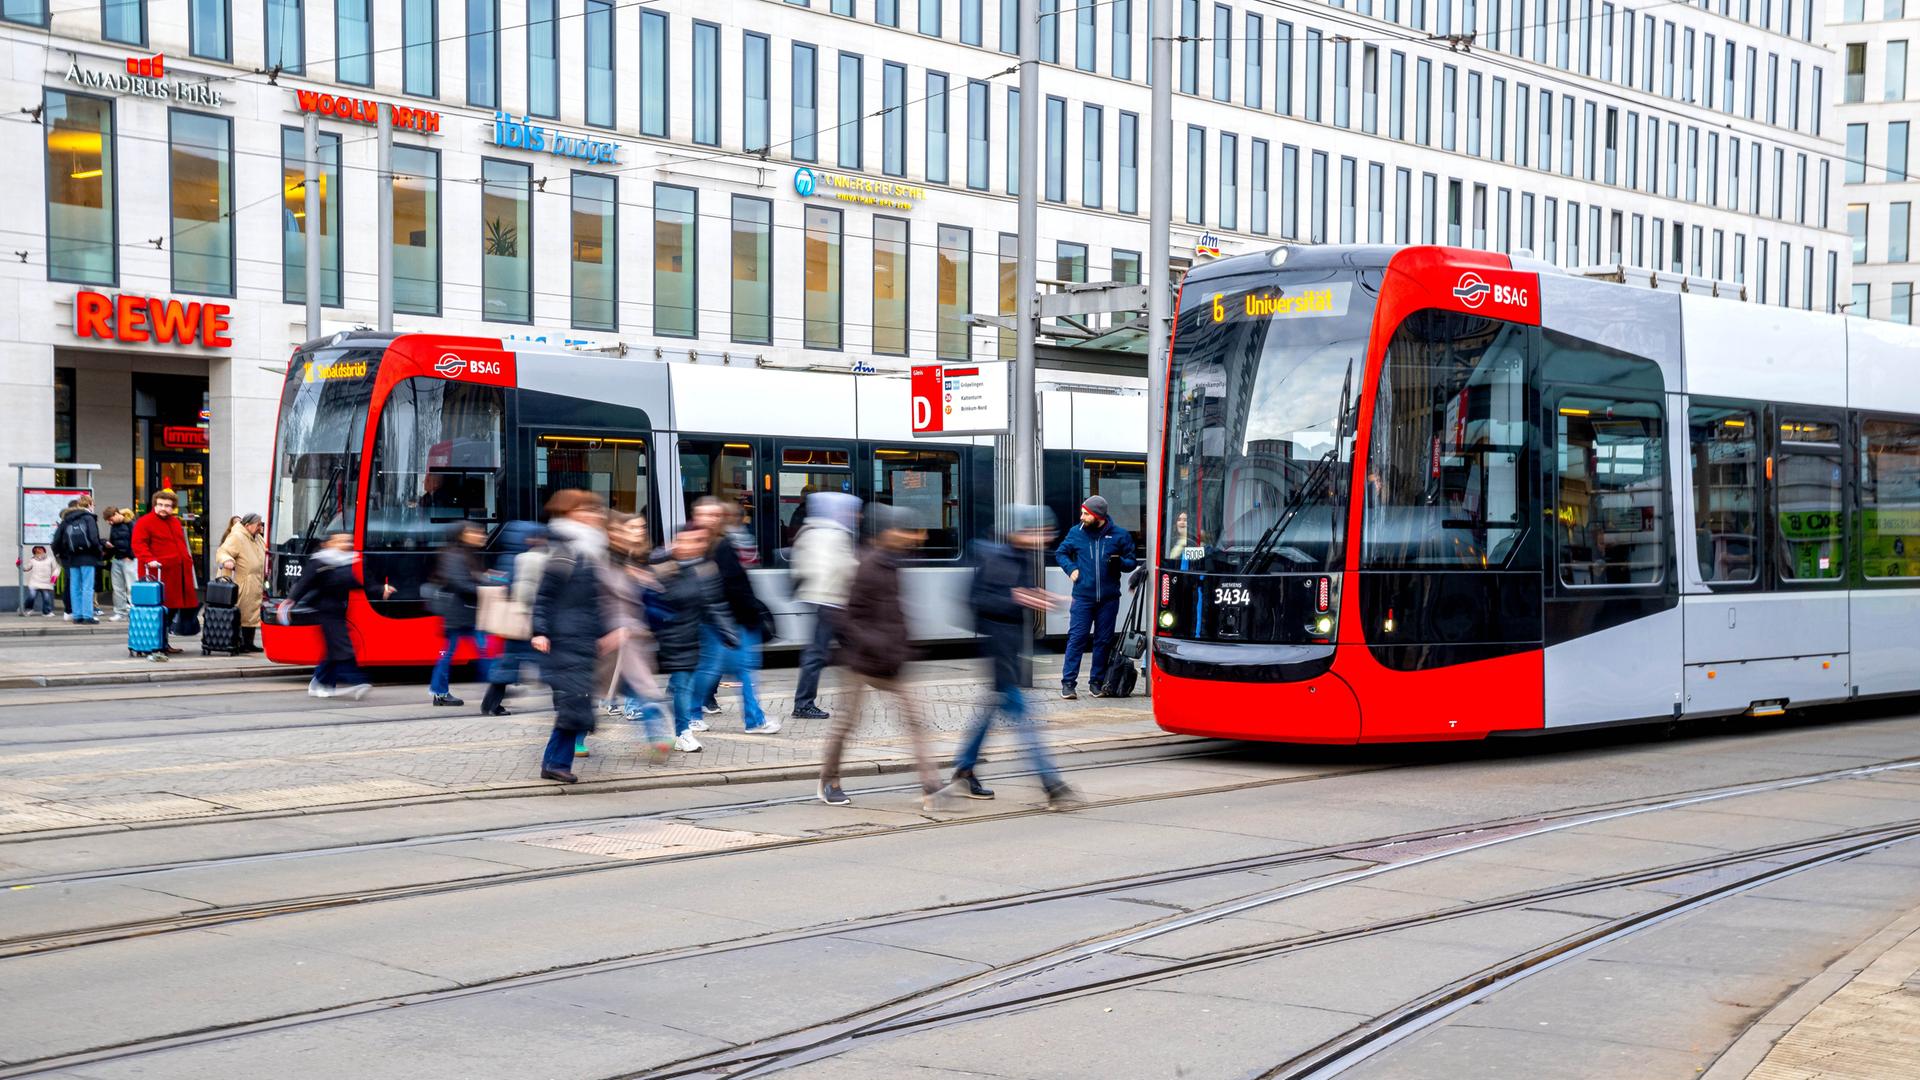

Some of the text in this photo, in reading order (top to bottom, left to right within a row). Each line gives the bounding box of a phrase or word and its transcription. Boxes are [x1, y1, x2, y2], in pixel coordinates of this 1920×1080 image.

[494, 111, 621, 165] ibis budget
[1201, 231, 1218, 247] dm
[1213, 288, 1333, 322] 6 Universität
[1494, 284, 1528, 307] BSAG
[75, 291, 233, 348] REWE
[469, 360, 501, 375] BSAG
[913, 395, 932, 430] D
[1185, 549, 1204, 560] 6009
[284, 564, 302, 577] 3212
[1214, 588, 1251, 605] 3434
